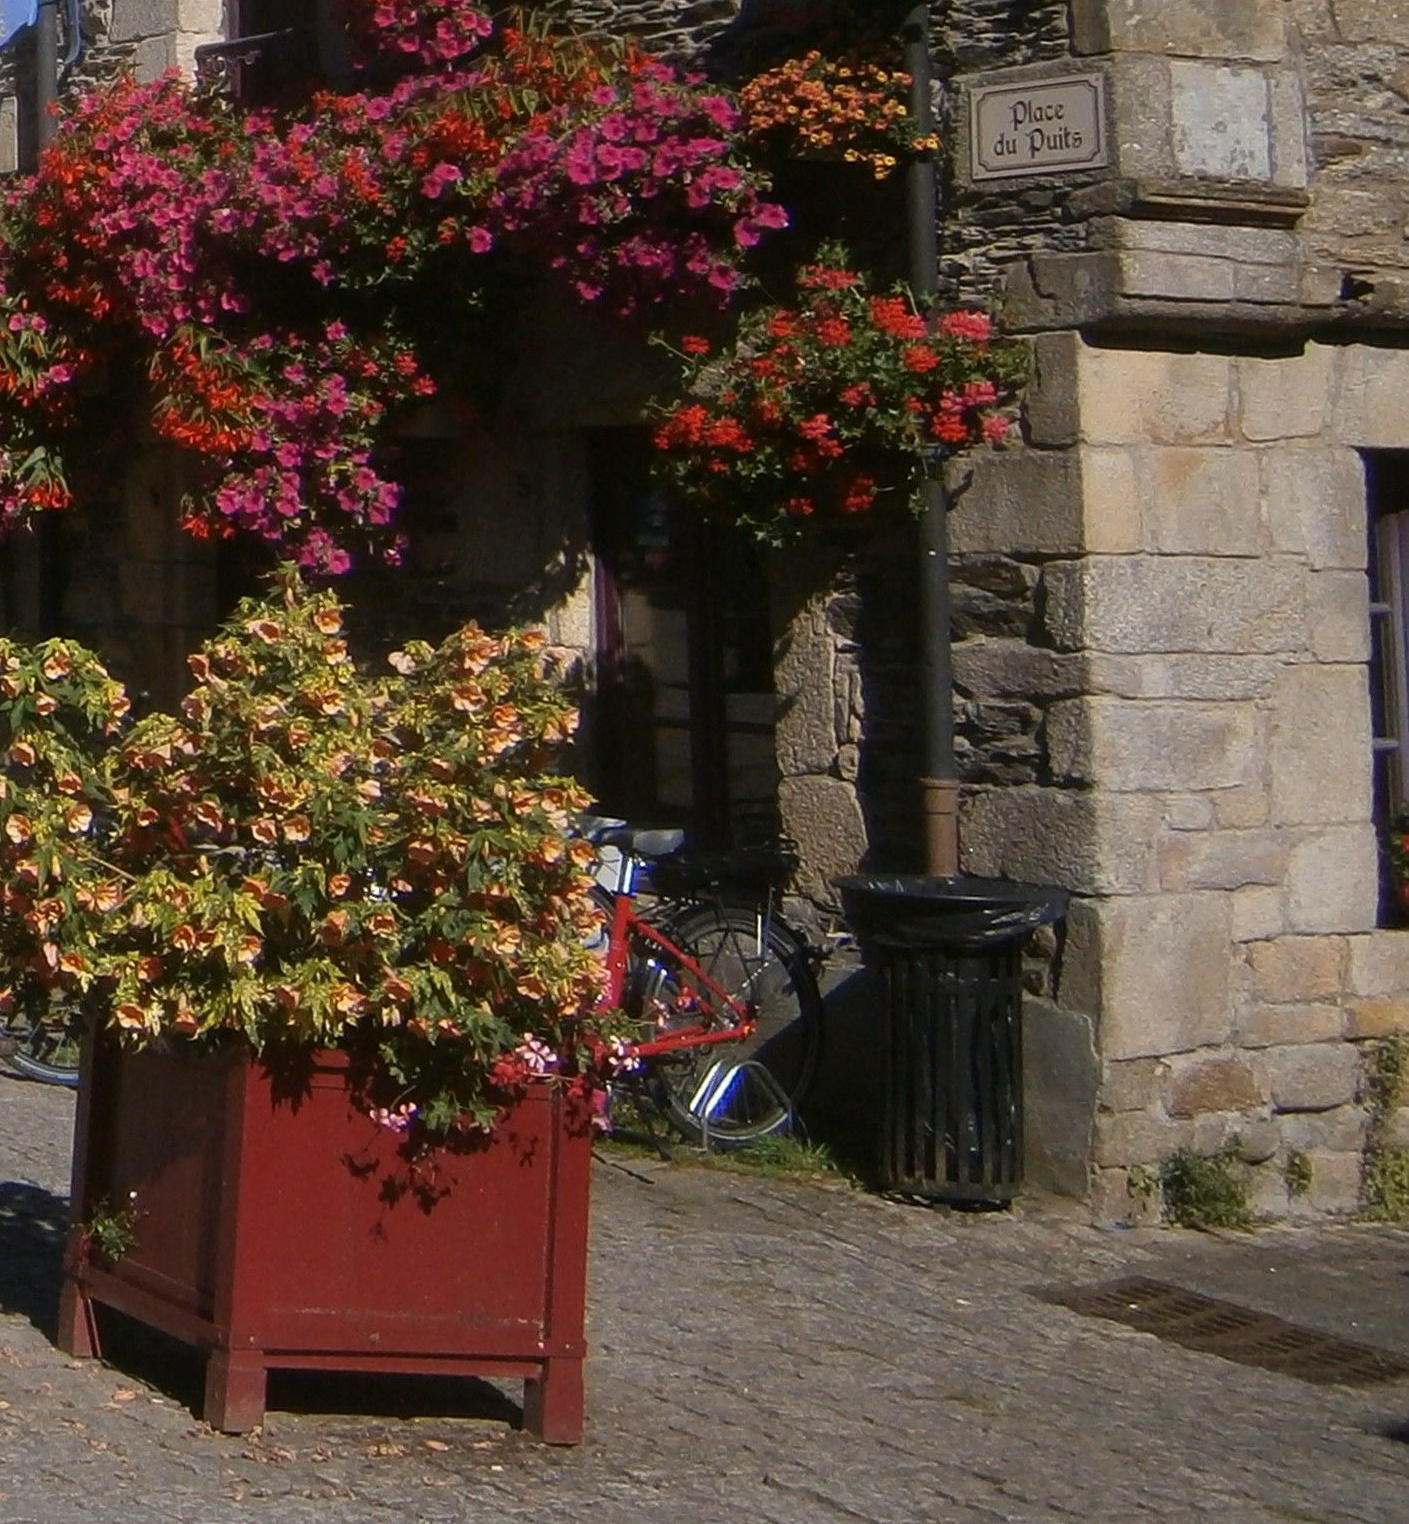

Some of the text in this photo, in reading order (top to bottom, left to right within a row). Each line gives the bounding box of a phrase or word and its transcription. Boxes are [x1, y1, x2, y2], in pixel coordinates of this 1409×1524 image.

[1008, 100, 1065, 131] Place
[993, 127, 1083, 159] du Puits
